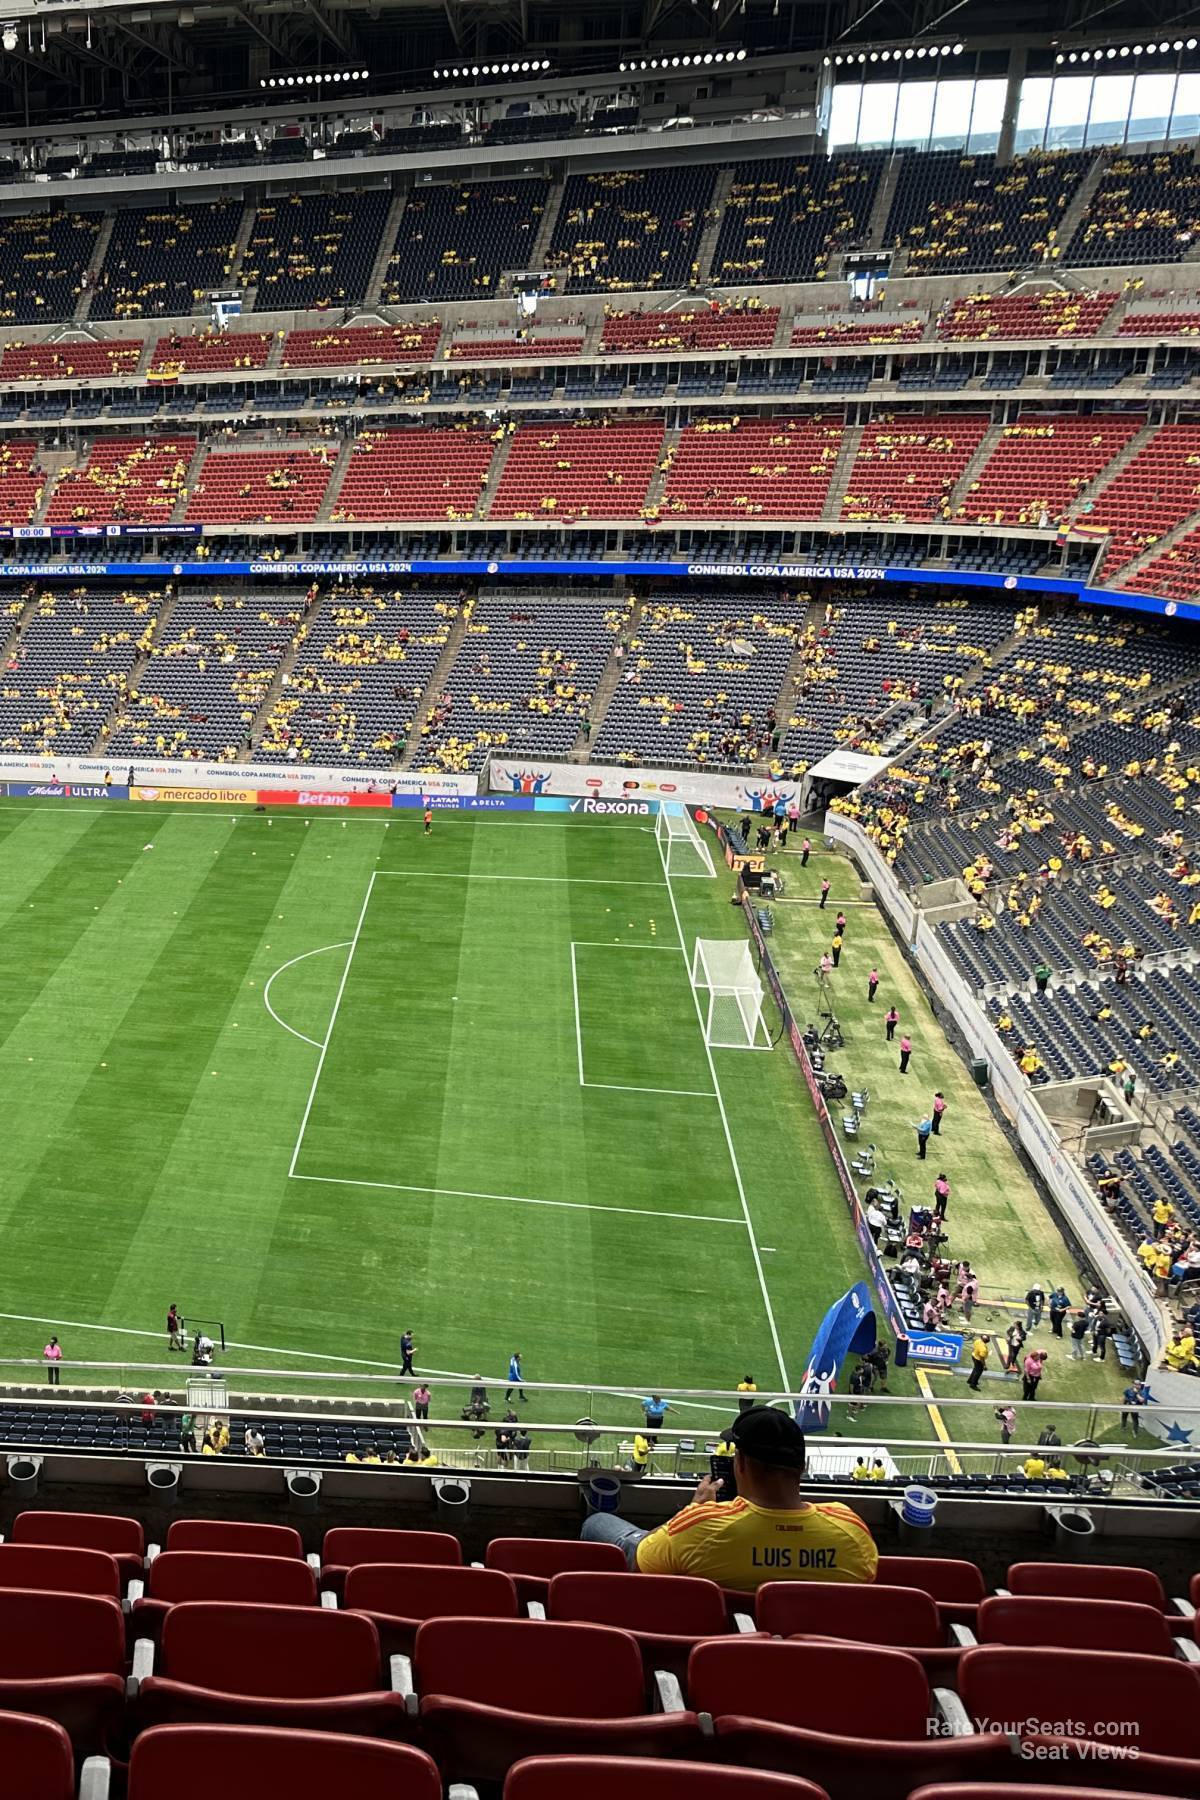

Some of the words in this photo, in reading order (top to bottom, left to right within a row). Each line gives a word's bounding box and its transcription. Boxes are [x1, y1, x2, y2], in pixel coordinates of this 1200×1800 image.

[7, 566, 30, 575] COPA
[30, 565, 69, 575] AMERICA
[69, 565, 86, 575] USA
[249, 563, 299, 574] CONMEBOL
[300, 564, 326, 573] COPA
[326, 563, 368, 573] AMERICA
[369, 563, 388, 573] USA
[687, 564, 749, 576] CONMEBOL
[749, 565, 780, 577] COPA
[780, 566, 832, 578] AMERICA
[833, 568, 856, 579] USA
[206, 769, 241, 777] CONMEBOL
[241, 770, 258, 778] COPA
[258, 771, 287, 779] AMERICA
[398, 779, 427, 787] AMERICA
[427, 780, 441, 788] USA
[72, 787, 109, 798] ULTRA
[163, 789, 218, 801] mercado
[219, 790, 247, 802] libre
[298, 791, 350, 806] Betano
[430, 796, 460, 804] LATAM
[479, 799, 505, 807] DELTA
[583, 798, 649, 815] Rexona
[909, 1341, 953, 1357] LOWE'S
[752, 1546, 792, 1568] LUIS
[799, 1547, 837, 1569] DIAZ
